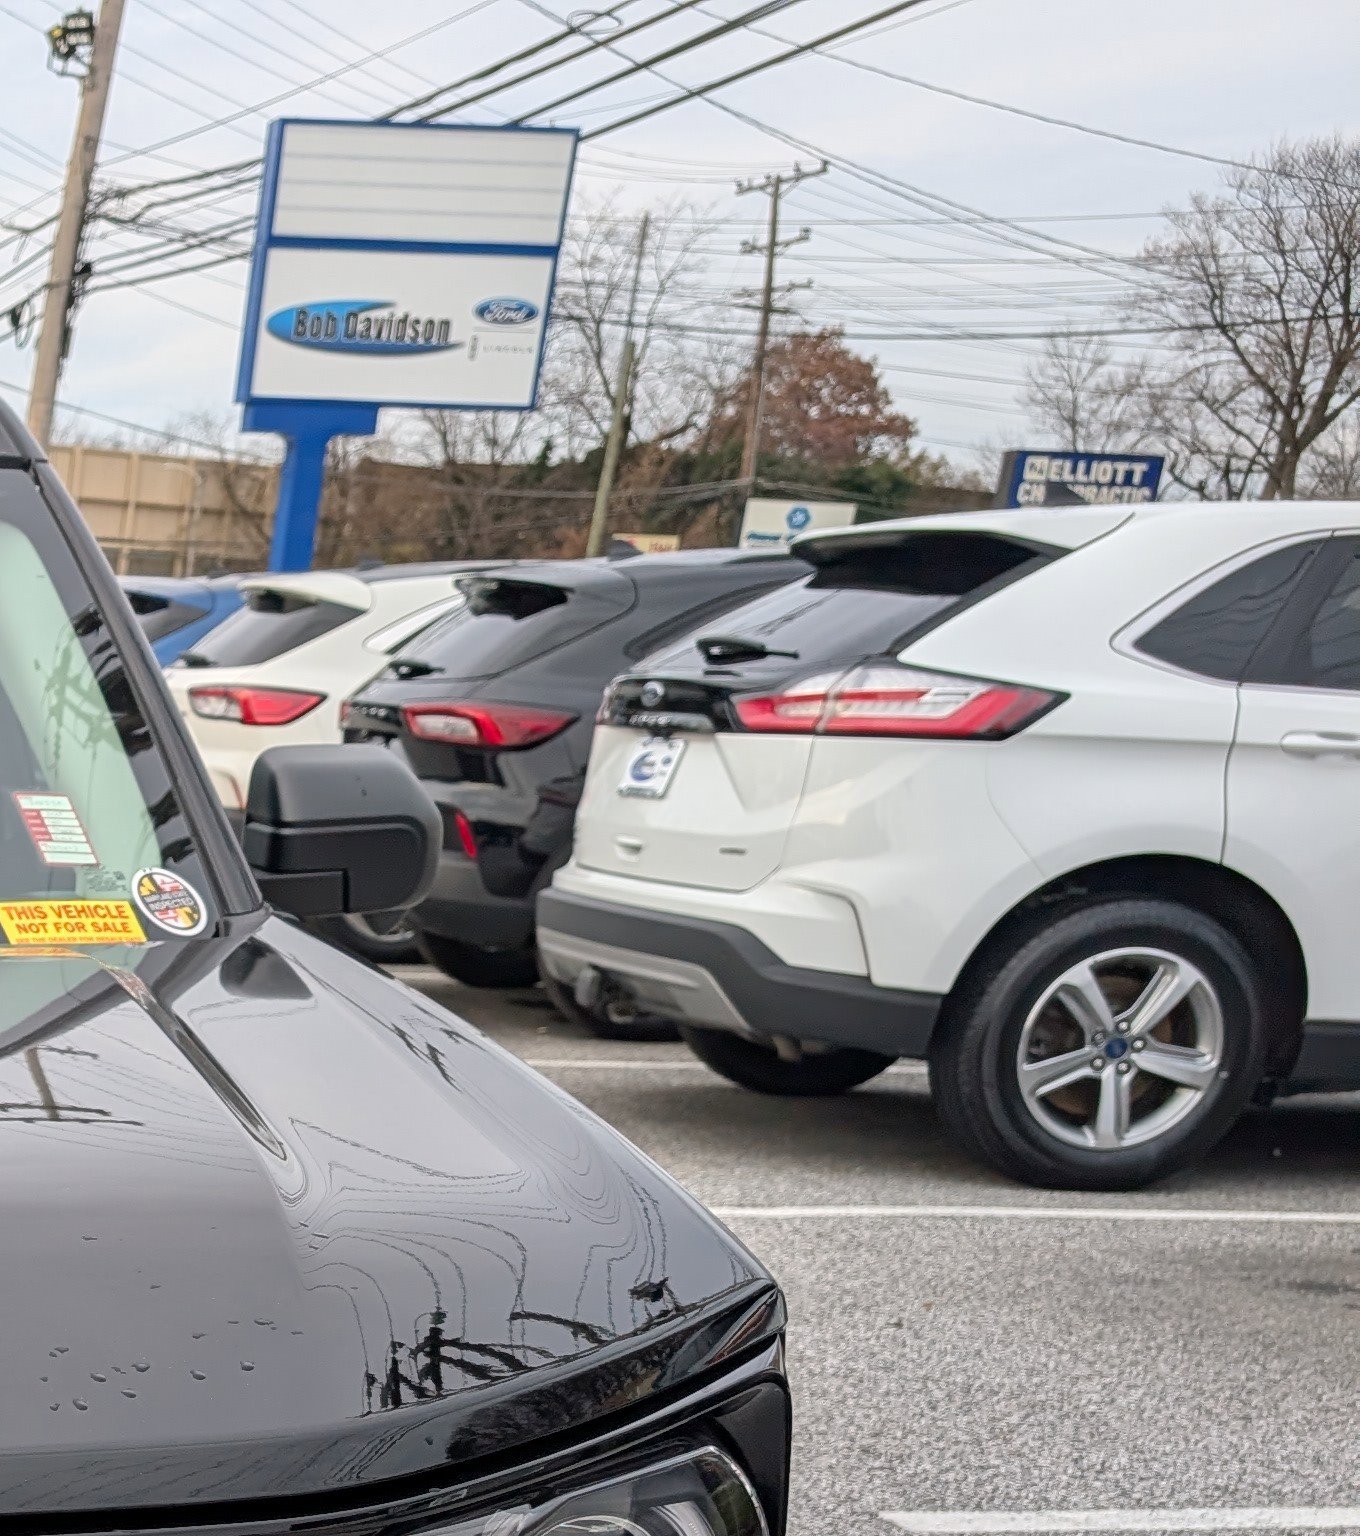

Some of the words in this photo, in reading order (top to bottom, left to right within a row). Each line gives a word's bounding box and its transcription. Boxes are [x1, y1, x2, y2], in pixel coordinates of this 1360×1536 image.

[483, 301, 530, 321] Ford
[294, 309, 337, 338] Bob
[343, 311, 451, 346] Davidson
[1048, 458, 1149, 485] ELLIOTT
[2, 905, 48, 920] THIS
[49, 904, 130, 919] VEHICLE
[15, 922, 49, 934] NOT
[52, 922, 88, 933] FOR
[91, 921, 133, 933] SALE
